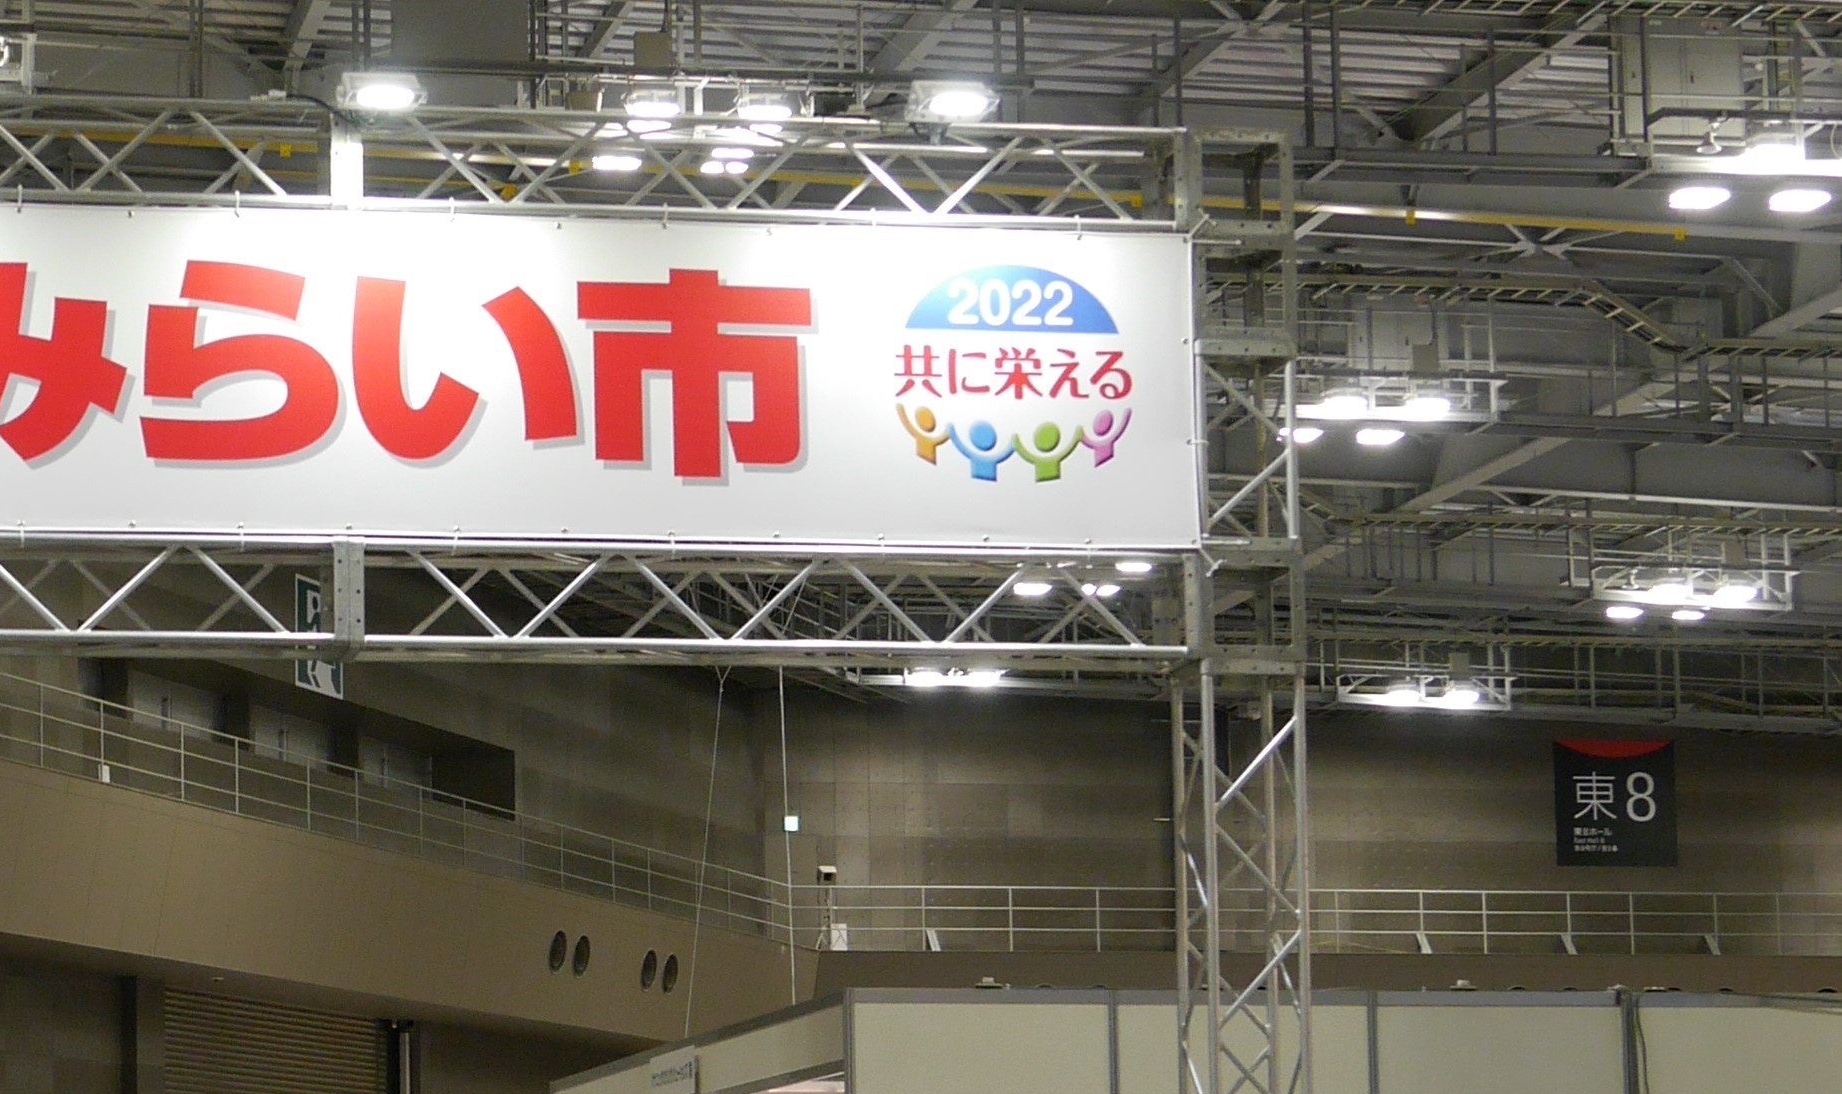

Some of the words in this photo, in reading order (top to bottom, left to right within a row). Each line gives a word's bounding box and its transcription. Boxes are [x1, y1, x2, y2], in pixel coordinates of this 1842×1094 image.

[946, 278, 1075, 327] 2022
[894, 344, 1134, 402] 共に栄える
